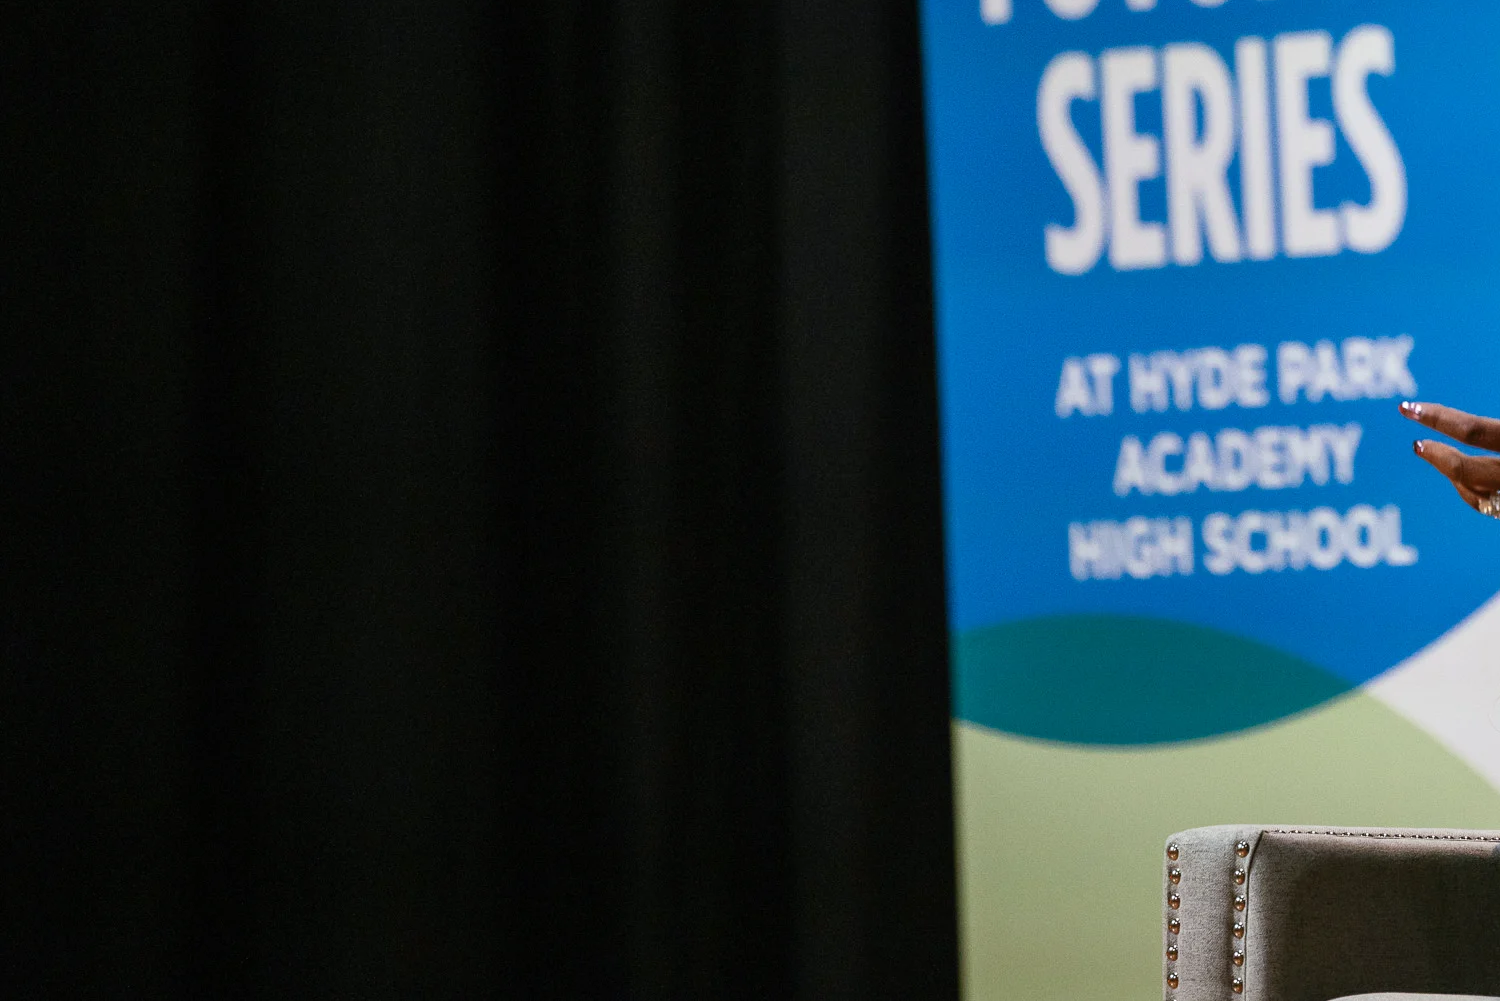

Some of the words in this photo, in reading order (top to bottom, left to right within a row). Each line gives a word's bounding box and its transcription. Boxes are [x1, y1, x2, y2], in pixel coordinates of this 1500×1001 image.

[1036, 23, 1408, 276] SERIES
[1055, 354, 1120, 418] AT
[1128, 344, 1270, 413] HYDE
[1276, 334, 1418, 404] PARK
[1112, 422, 1363, 497] ACADEMY
[1068, 516, 1195, 581] HIGH
[1202, 503, 1419, 575] SCHOOL
